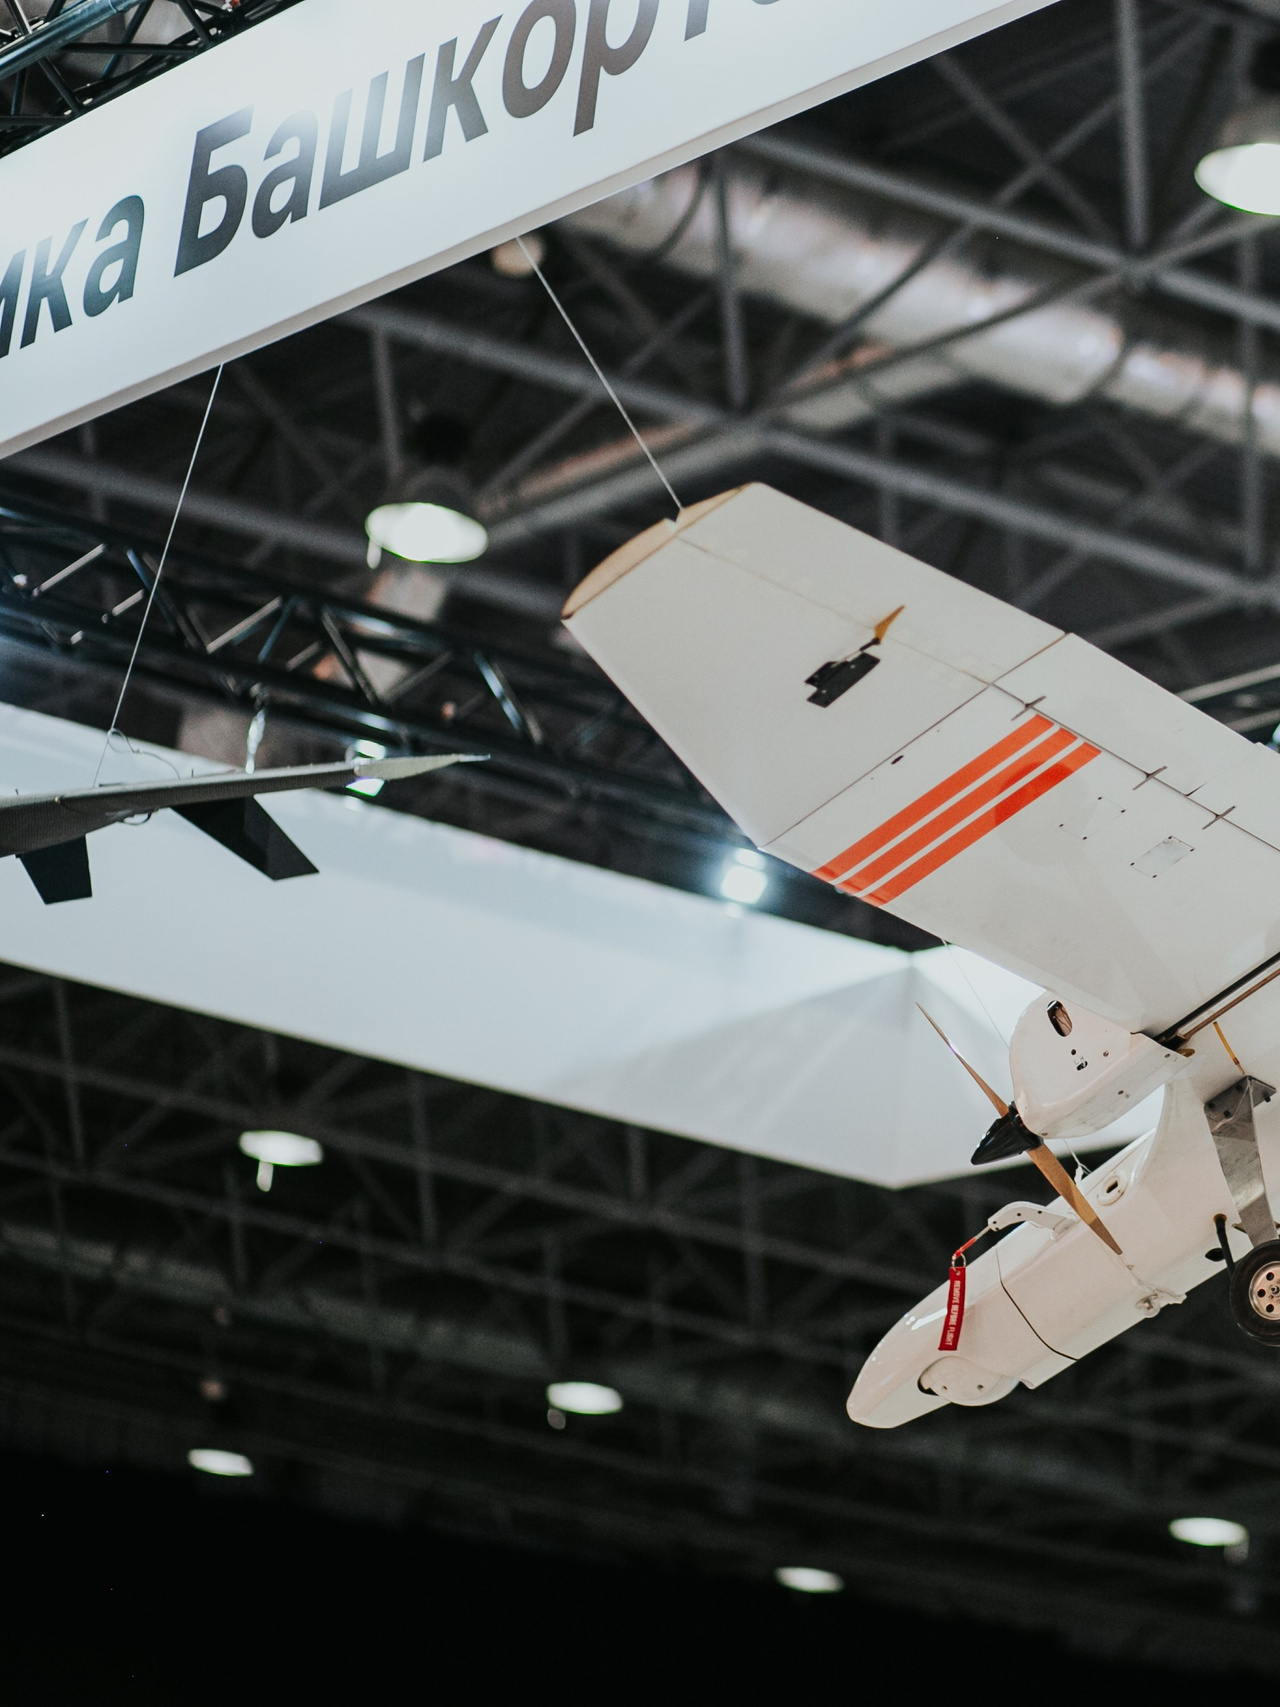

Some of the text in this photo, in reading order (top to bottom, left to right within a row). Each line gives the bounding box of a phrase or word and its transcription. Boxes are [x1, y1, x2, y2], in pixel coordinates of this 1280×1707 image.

[173, 0, 781, 278] Башкор
[945, 1280, 961, 1346] REMOVE BEFORE FLIGHT
